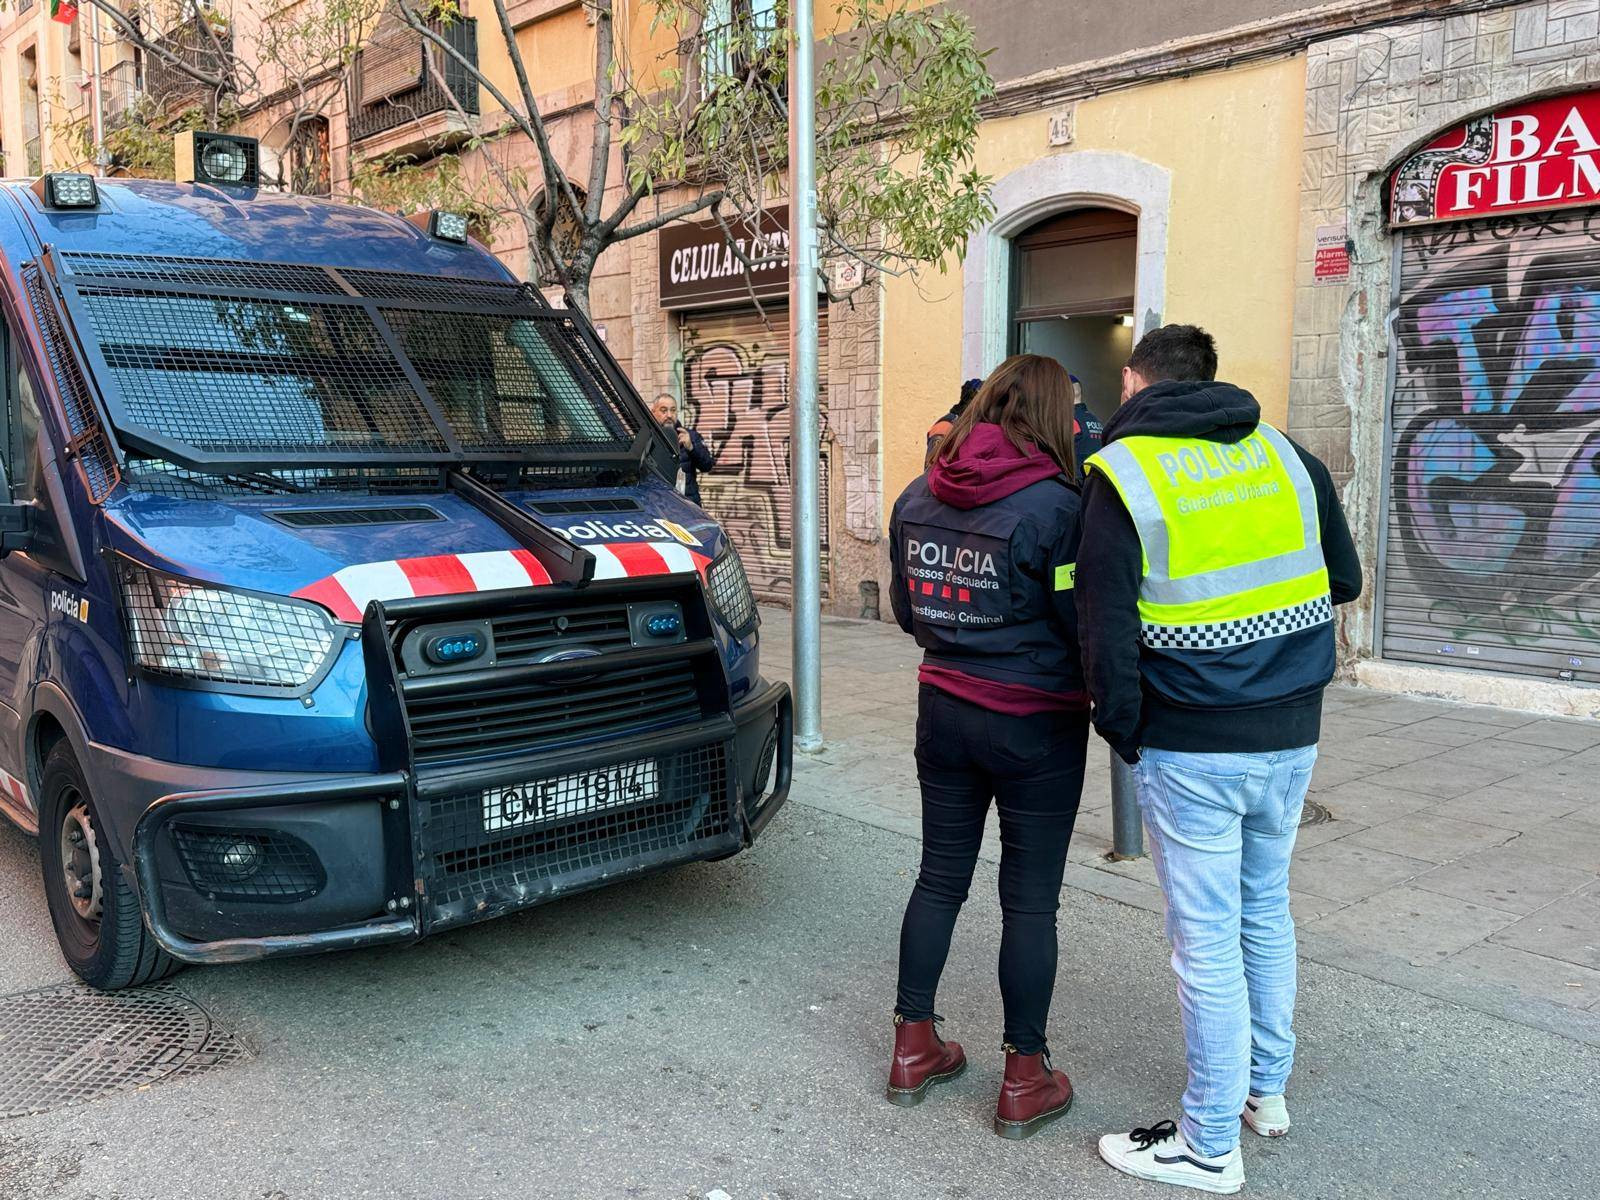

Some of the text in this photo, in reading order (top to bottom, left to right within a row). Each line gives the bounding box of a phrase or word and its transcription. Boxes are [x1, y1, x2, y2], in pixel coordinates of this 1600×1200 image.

[1052, 118, 1068, 138] 45
[1489, 106, 1600, 165] BA
[670, 238, 746, 284] CELULAR
[1157, 438, 1270, 487] POLICIA
[1236, 480, 1280, 502] Urbana
[907, 539, 998, 577] POLICIA
[907, 565, 999, 590] mossos d'esquadra
[51, 590, 79, 619] policia
[958, 611, 1004, 624] Criminal
[502, 766, 643, 822] CME 1914
